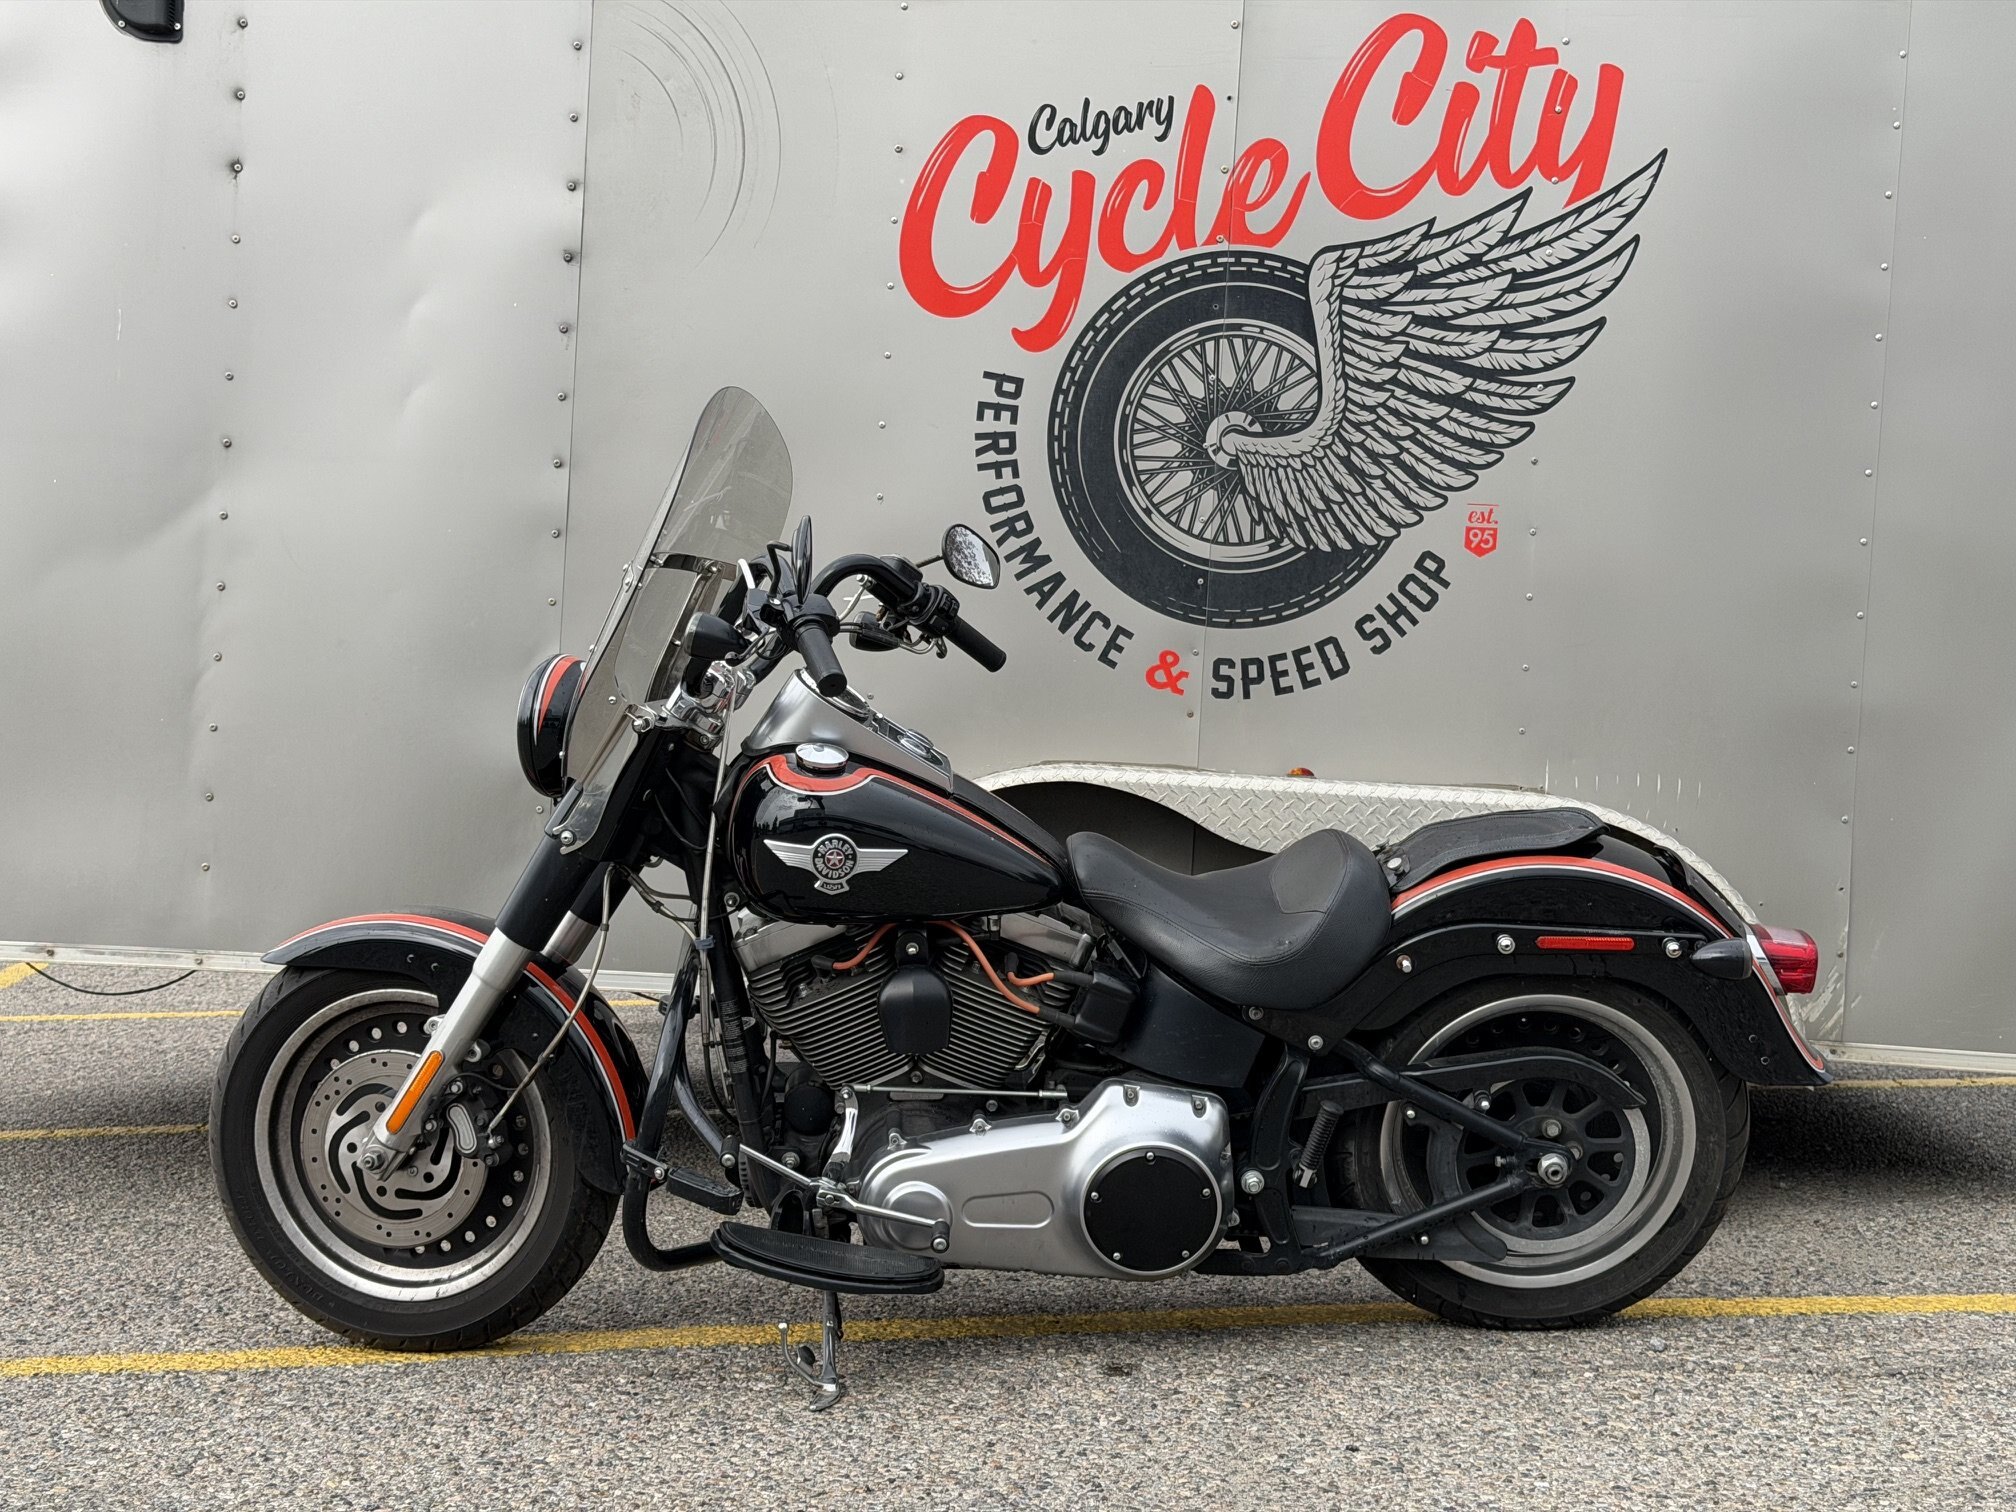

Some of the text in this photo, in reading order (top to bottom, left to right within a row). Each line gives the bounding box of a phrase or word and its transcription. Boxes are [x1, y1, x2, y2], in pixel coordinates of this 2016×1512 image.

[1027, 95, 1175, 156] Calgary
[898, 12, 1625, 353] Cycle City
[1467, 507, 1499, 525] est.
[974, 370, 1451, 700] PERFORMANCE & SPEED SHOP
[1469, 529, 1494, 549] 95
[818, 839, 854, 855] HARLEY
[814, 857, 855, 879] DAVIDSON
